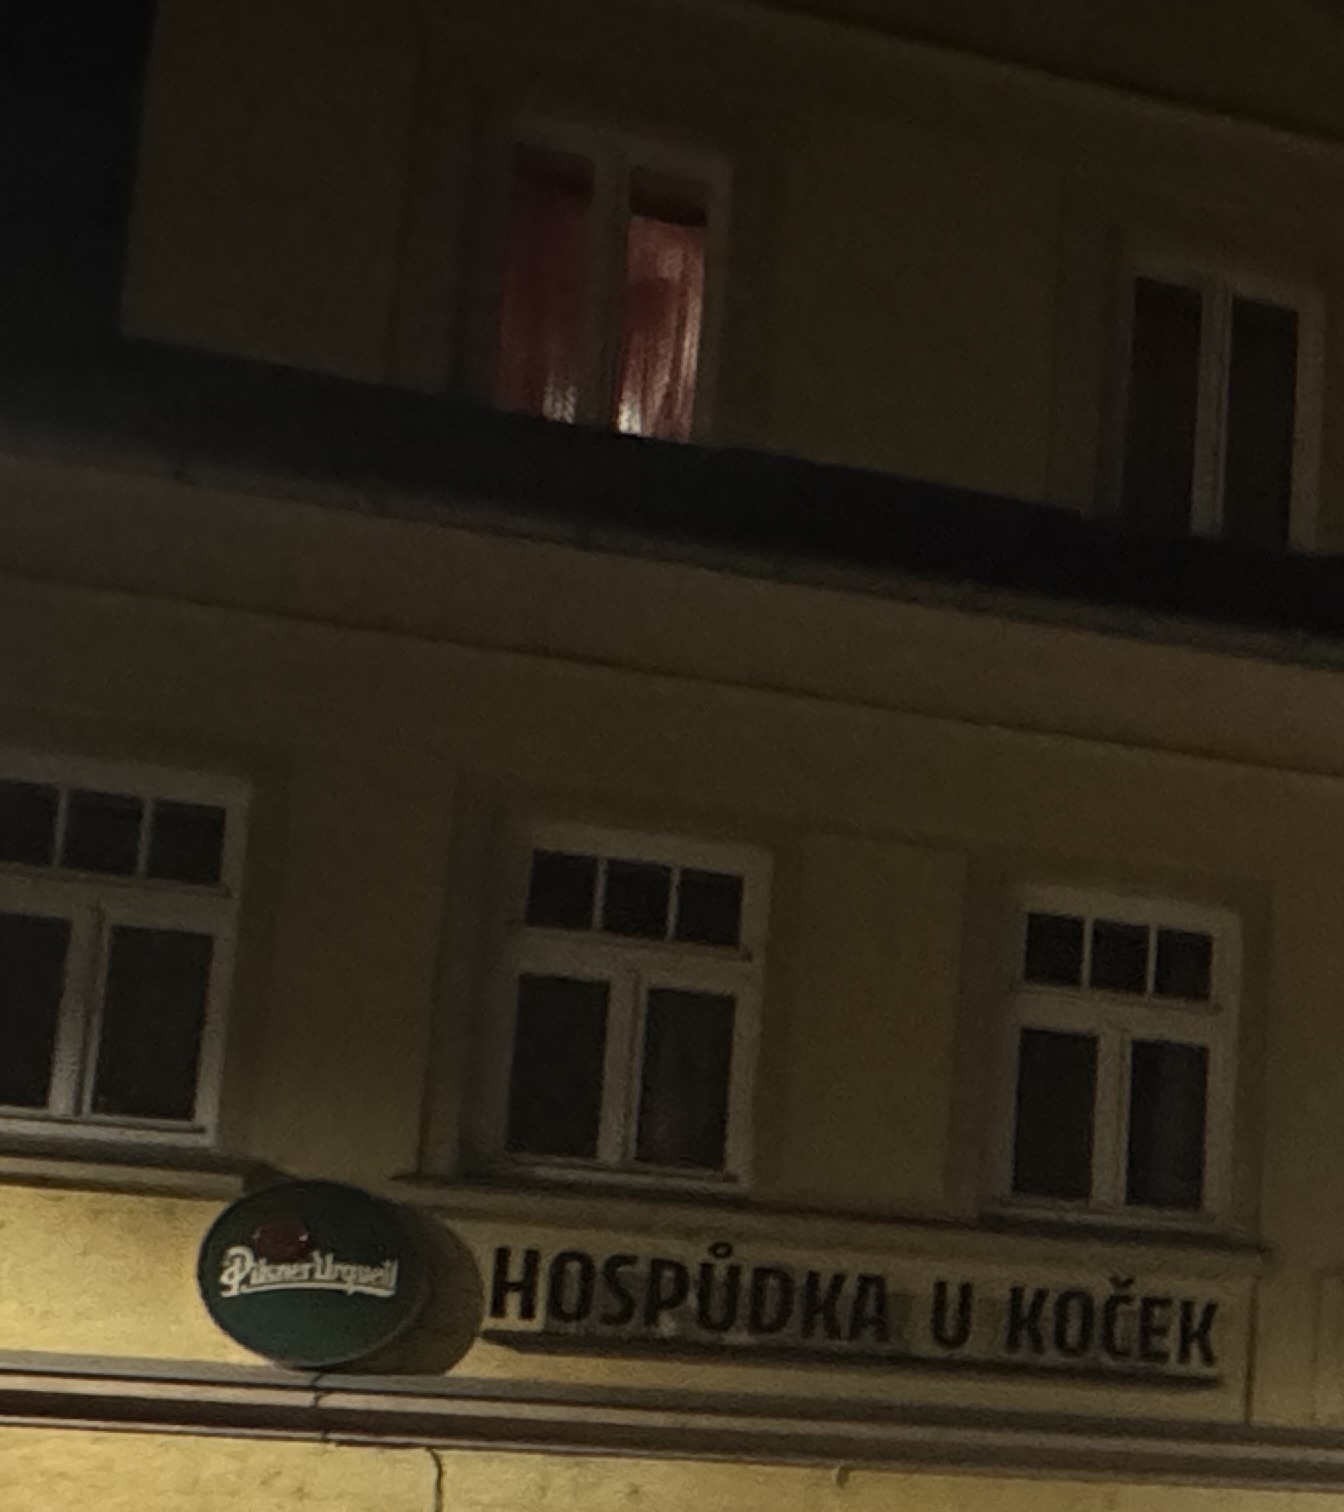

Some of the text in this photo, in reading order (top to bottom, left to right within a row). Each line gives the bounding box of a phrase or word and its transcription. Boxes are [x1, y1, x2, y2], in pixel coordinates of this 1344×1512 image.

[218, 1244, 400, 1296] Pilsner Urquell
[490, 1241, 1219, 1367] HOSPŮDKA U KOČEK
